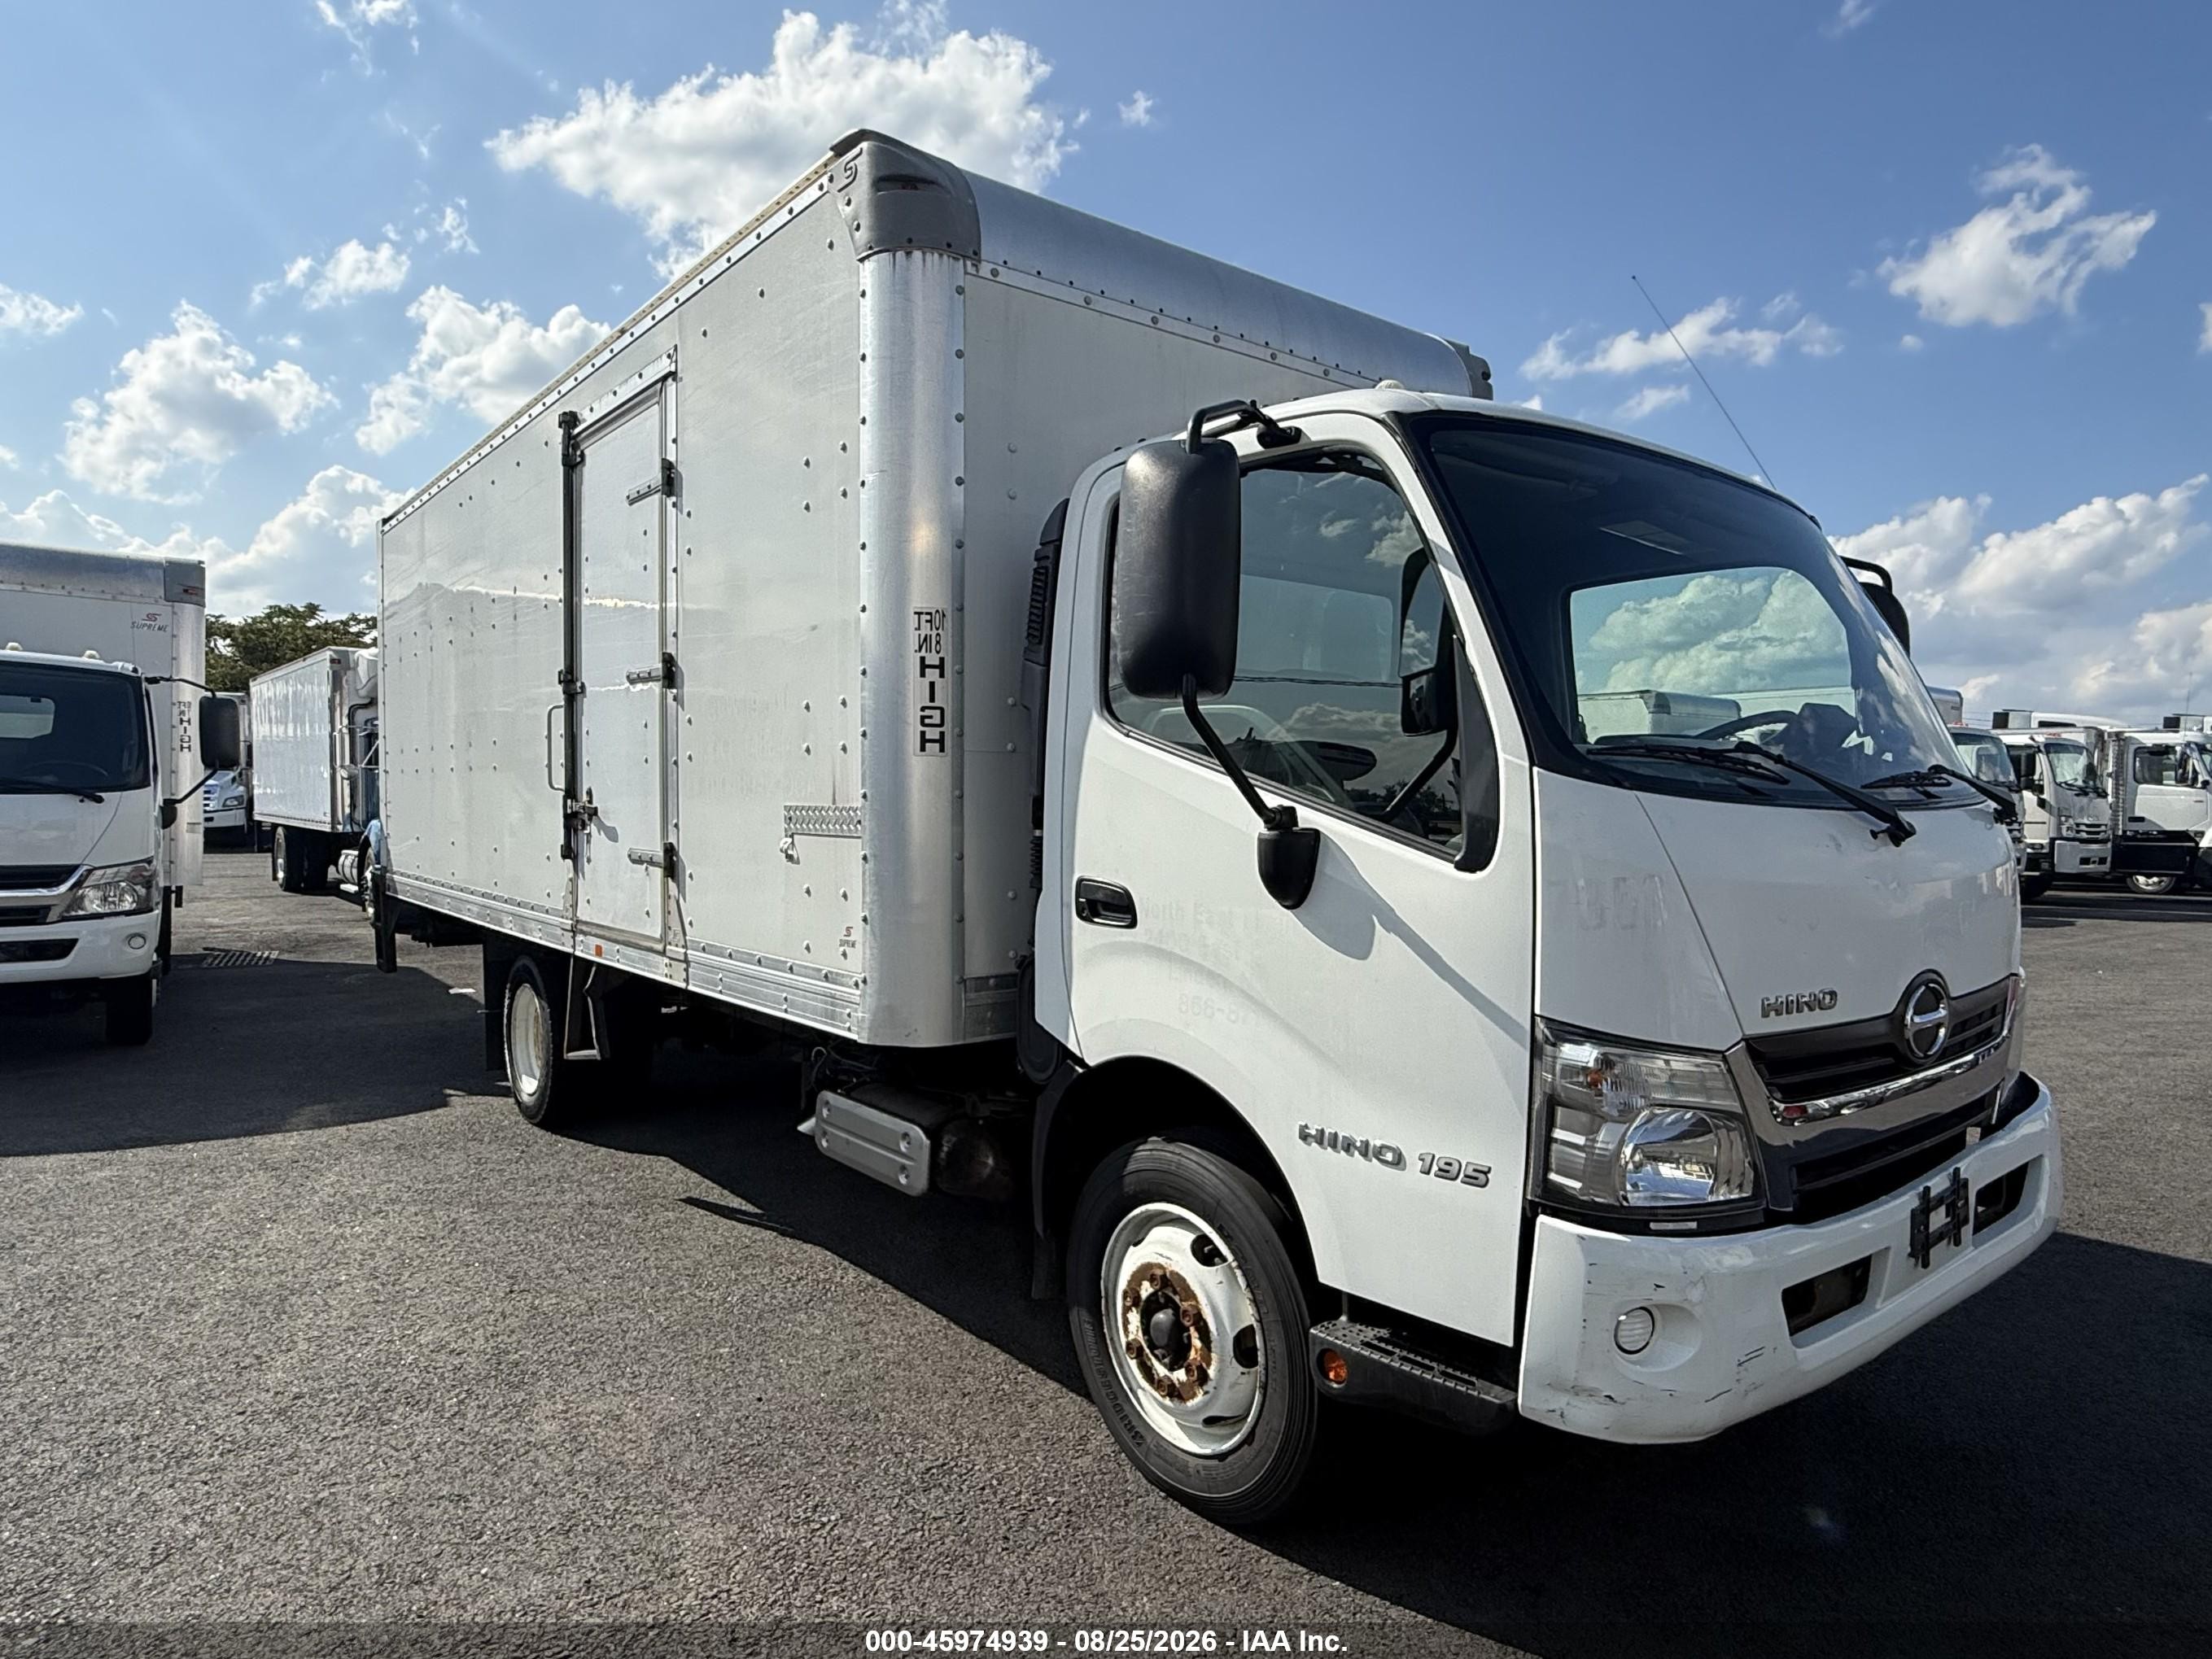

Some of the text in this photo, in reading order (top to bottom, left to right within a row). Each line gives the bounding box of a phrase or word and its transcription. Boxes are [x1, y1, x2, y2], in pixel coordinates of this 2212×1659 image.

[130, 621, 168, 633] SUPREME
[1760, 989, 1838, 1019] HINO
[1298, 1122, 1493, 1189] HINO 195
